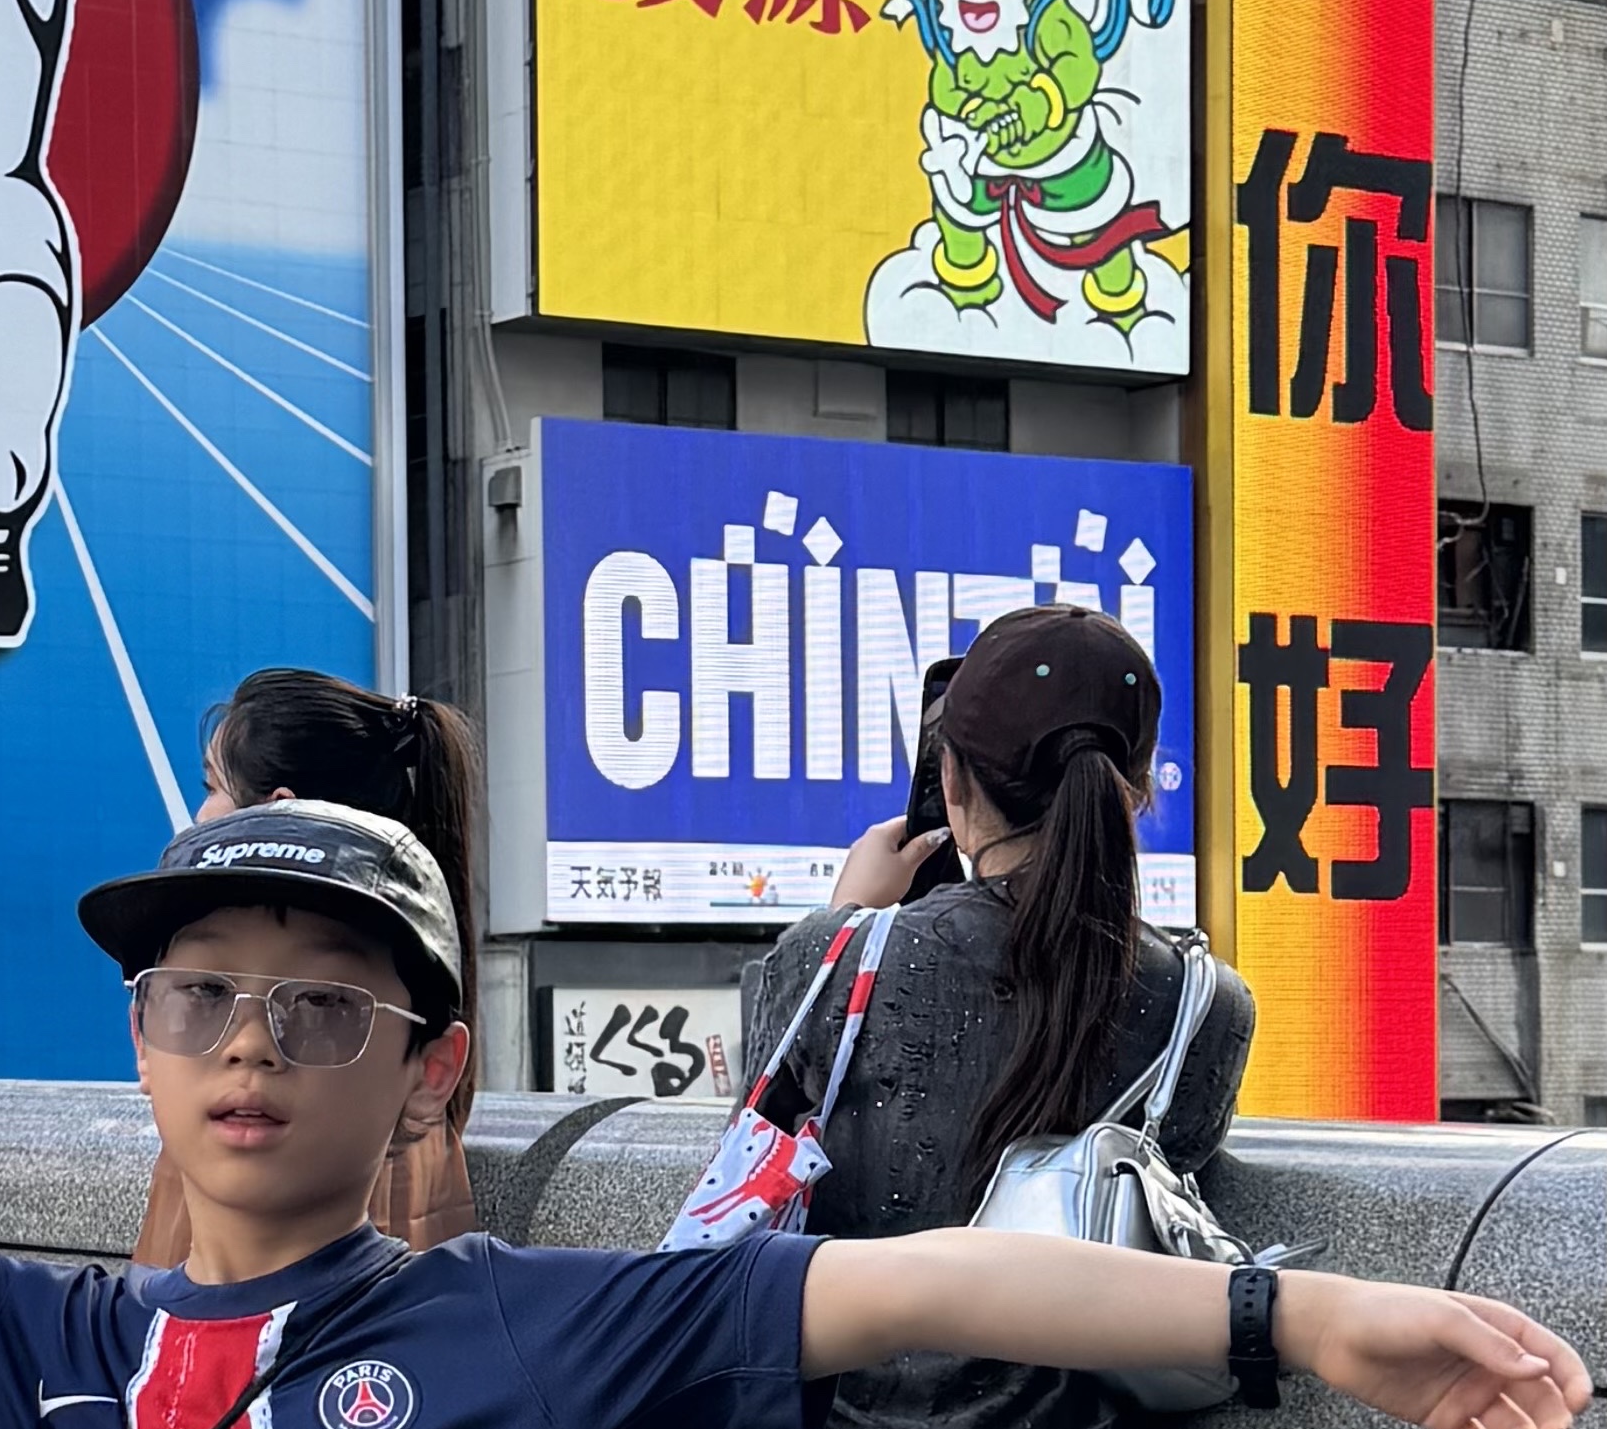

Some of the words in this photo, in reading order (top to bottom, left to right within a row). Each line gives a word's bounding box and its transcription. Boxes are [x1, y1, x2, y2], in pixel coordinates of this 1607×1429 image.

[1236, 127, 1434, 901] 你好
[196, 841, 326, 868] Supreme
[590, 1003, 706, 1097] くくる
[332, 1364, 393, 1389] PARIS
